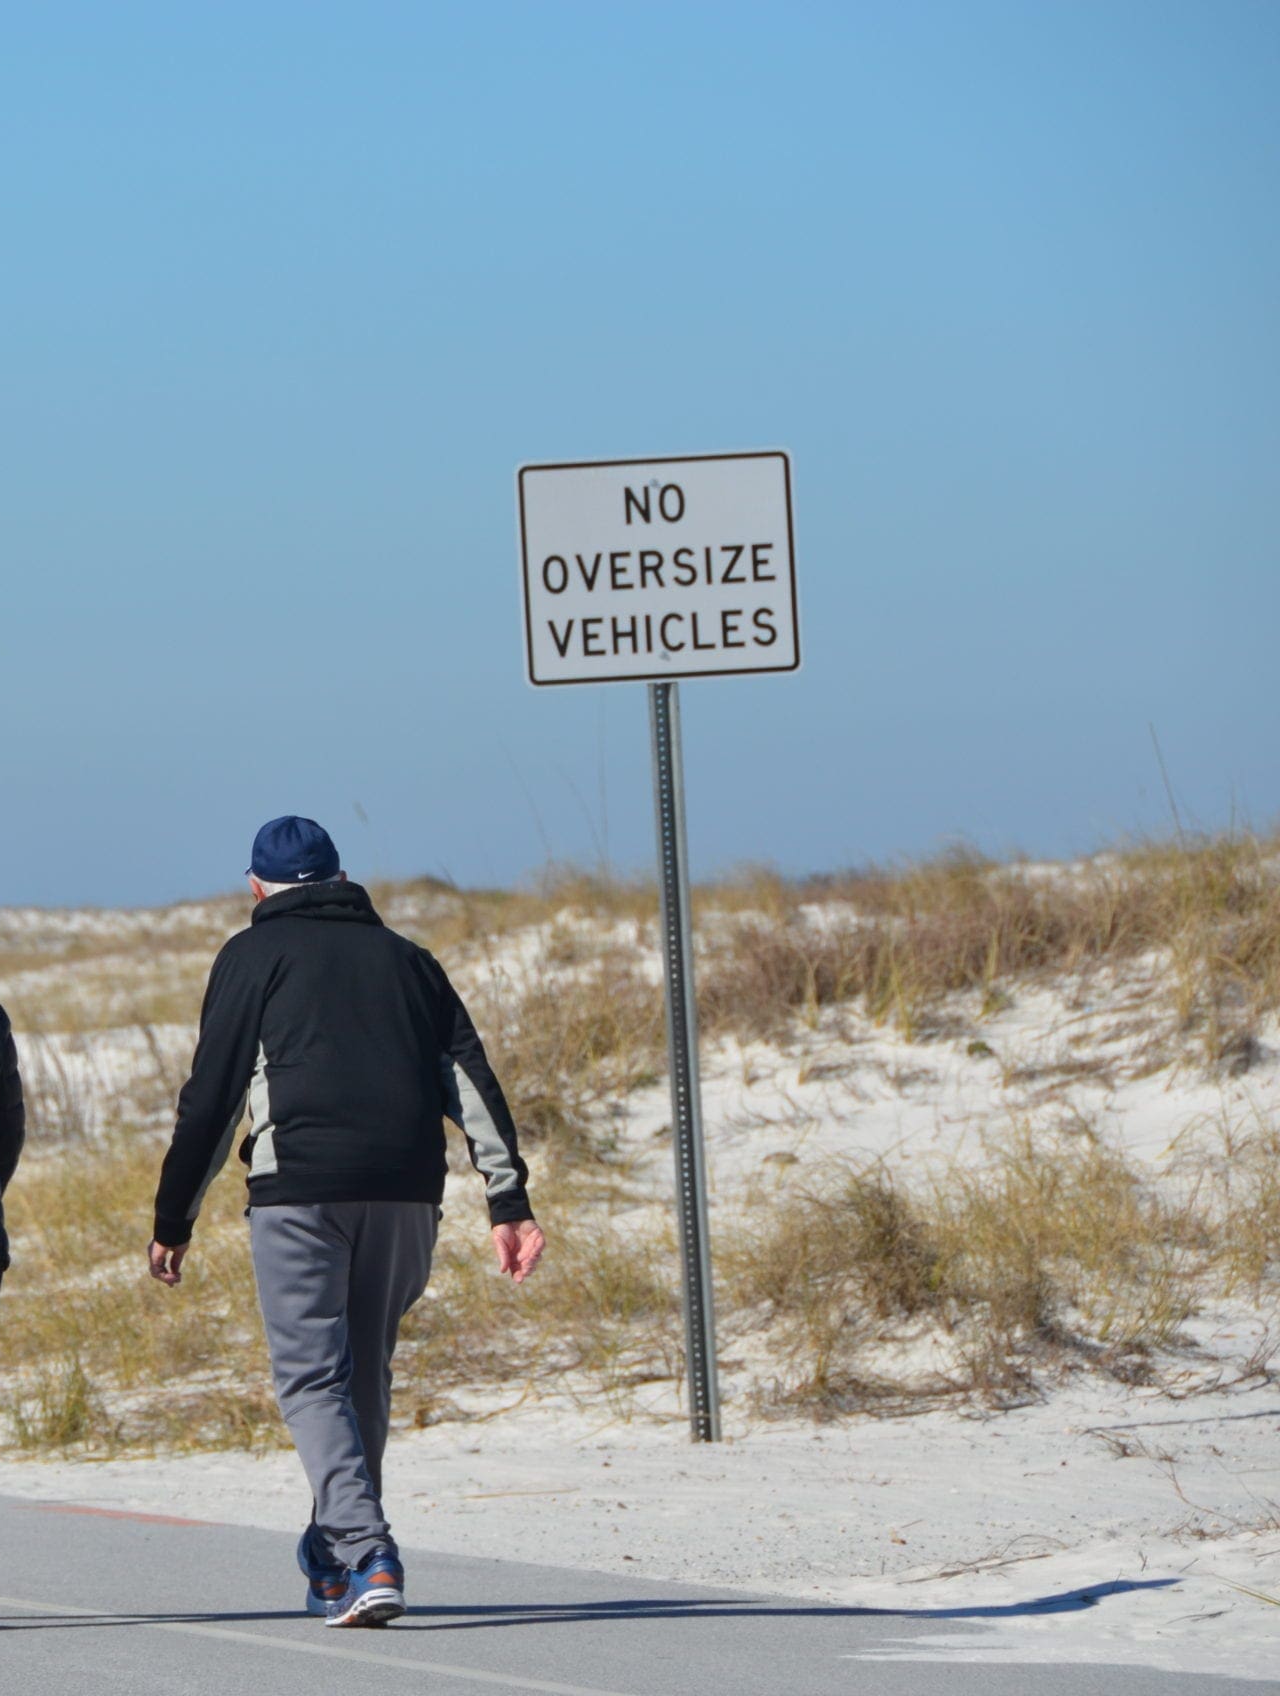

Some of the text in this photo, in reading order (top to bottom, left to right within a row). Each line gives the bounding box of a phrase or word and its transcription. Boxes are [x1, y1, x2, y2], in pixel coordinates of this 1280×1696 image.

[623, 484, 686, 525] NO
[541, 543, 777, 595] OVERSIZE
[547, 607, 778, 658] VEHICLES
